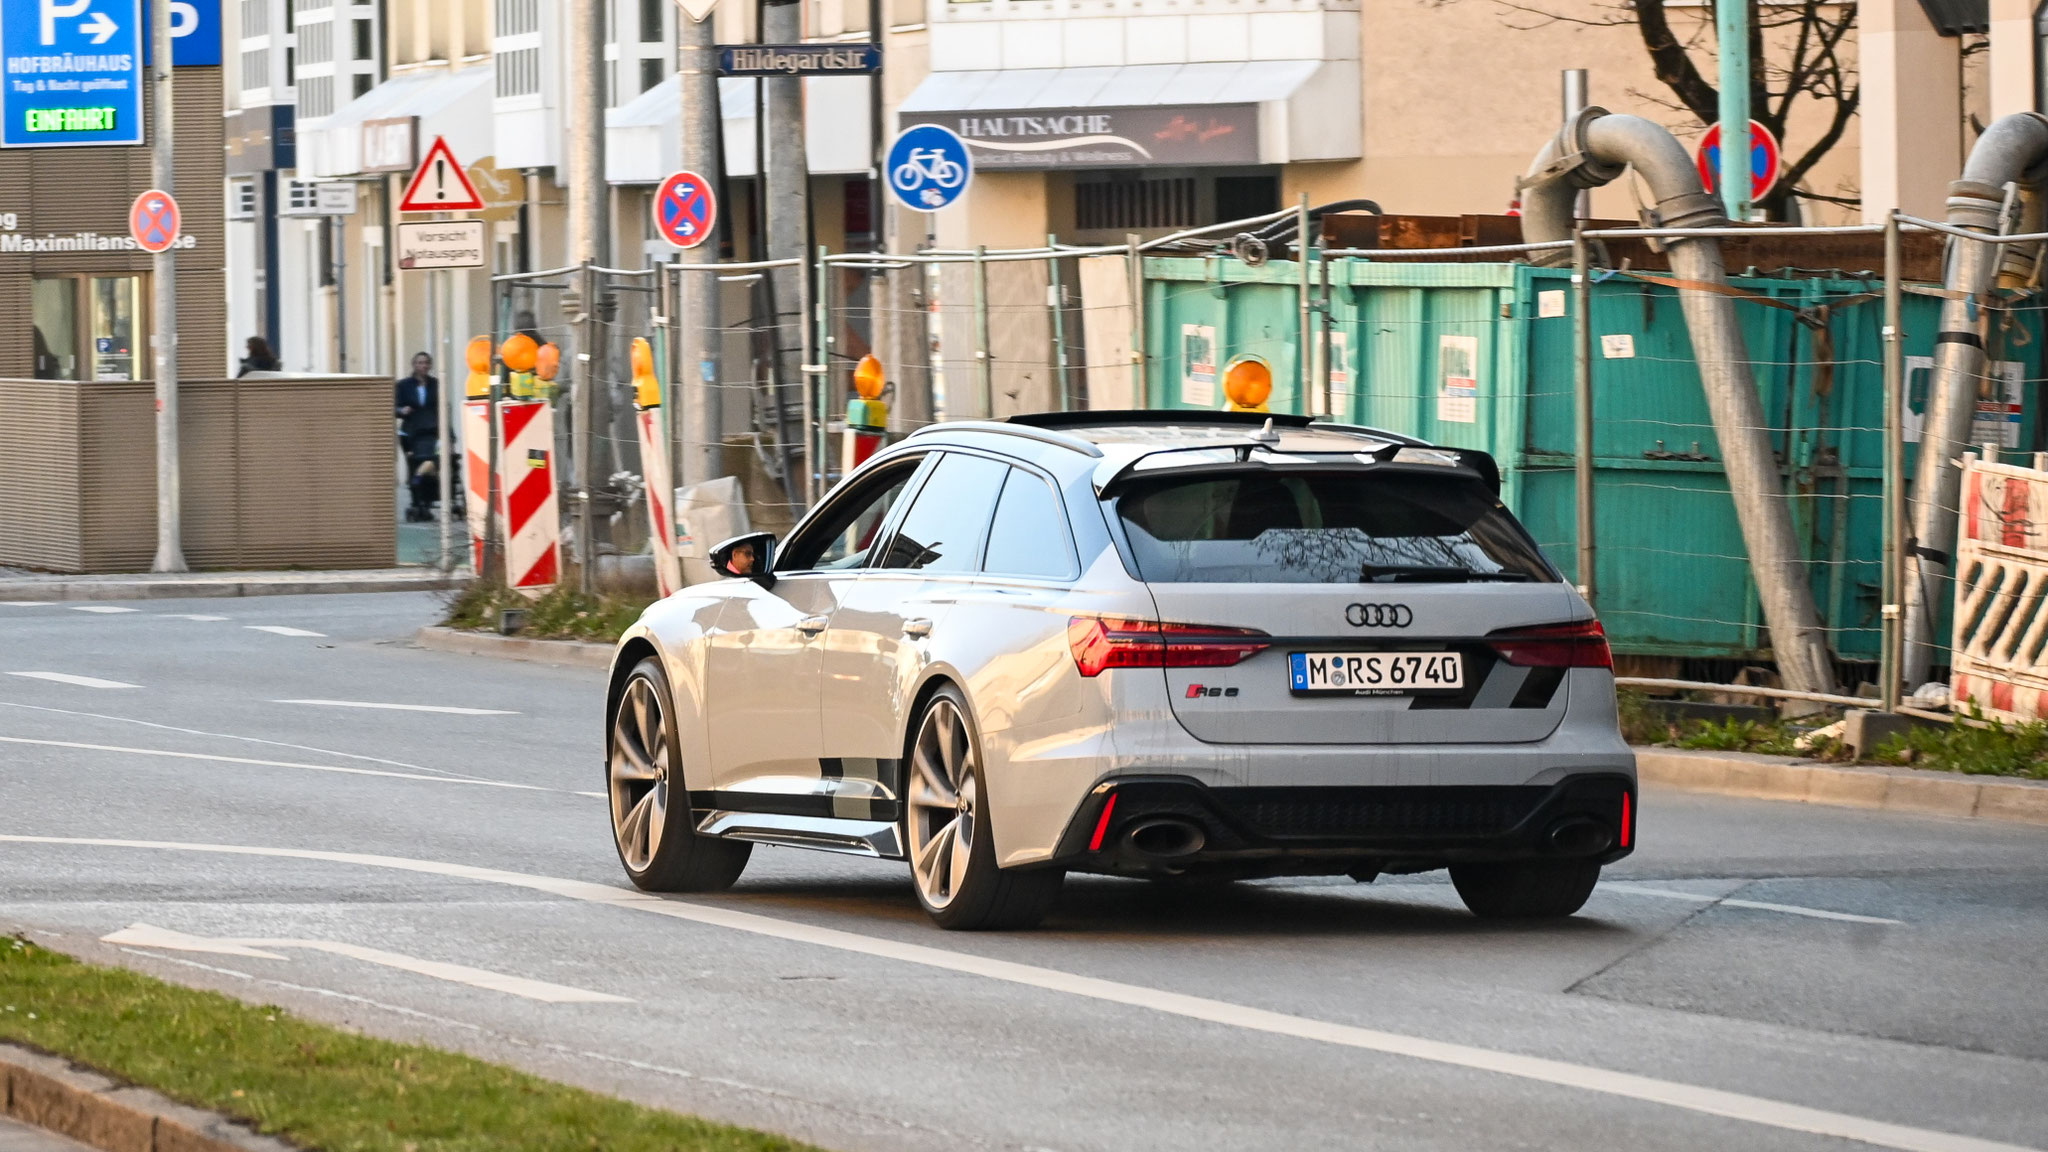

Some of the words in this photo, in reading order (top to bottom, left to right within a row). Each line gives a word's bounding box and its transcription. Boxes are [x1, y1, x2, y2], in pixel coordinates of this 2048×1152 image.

[7, 52, 131, 74] HOFBRÄUHAUS
[732, 48, 867, 73] Hildegardstr.
[13, 80, 34, 94] Tag
[25, 107, 116, 132] EINFAHRT
[960, 114, 1112, 136] HAUTSACHE
[1013, 152, 1057, 167] Beauty
[1074, 151, 1132, 162] Wellness
[417, 230, 467, 242] Vorsicht
[406, 248, 478, 261] Notausgang
[1296, 675, 1304, 684] D
[1309, 657, 1327, 684] M
[1347, 657, 1383, 684] RS
[1390, 656, 1458, 684] 6740
